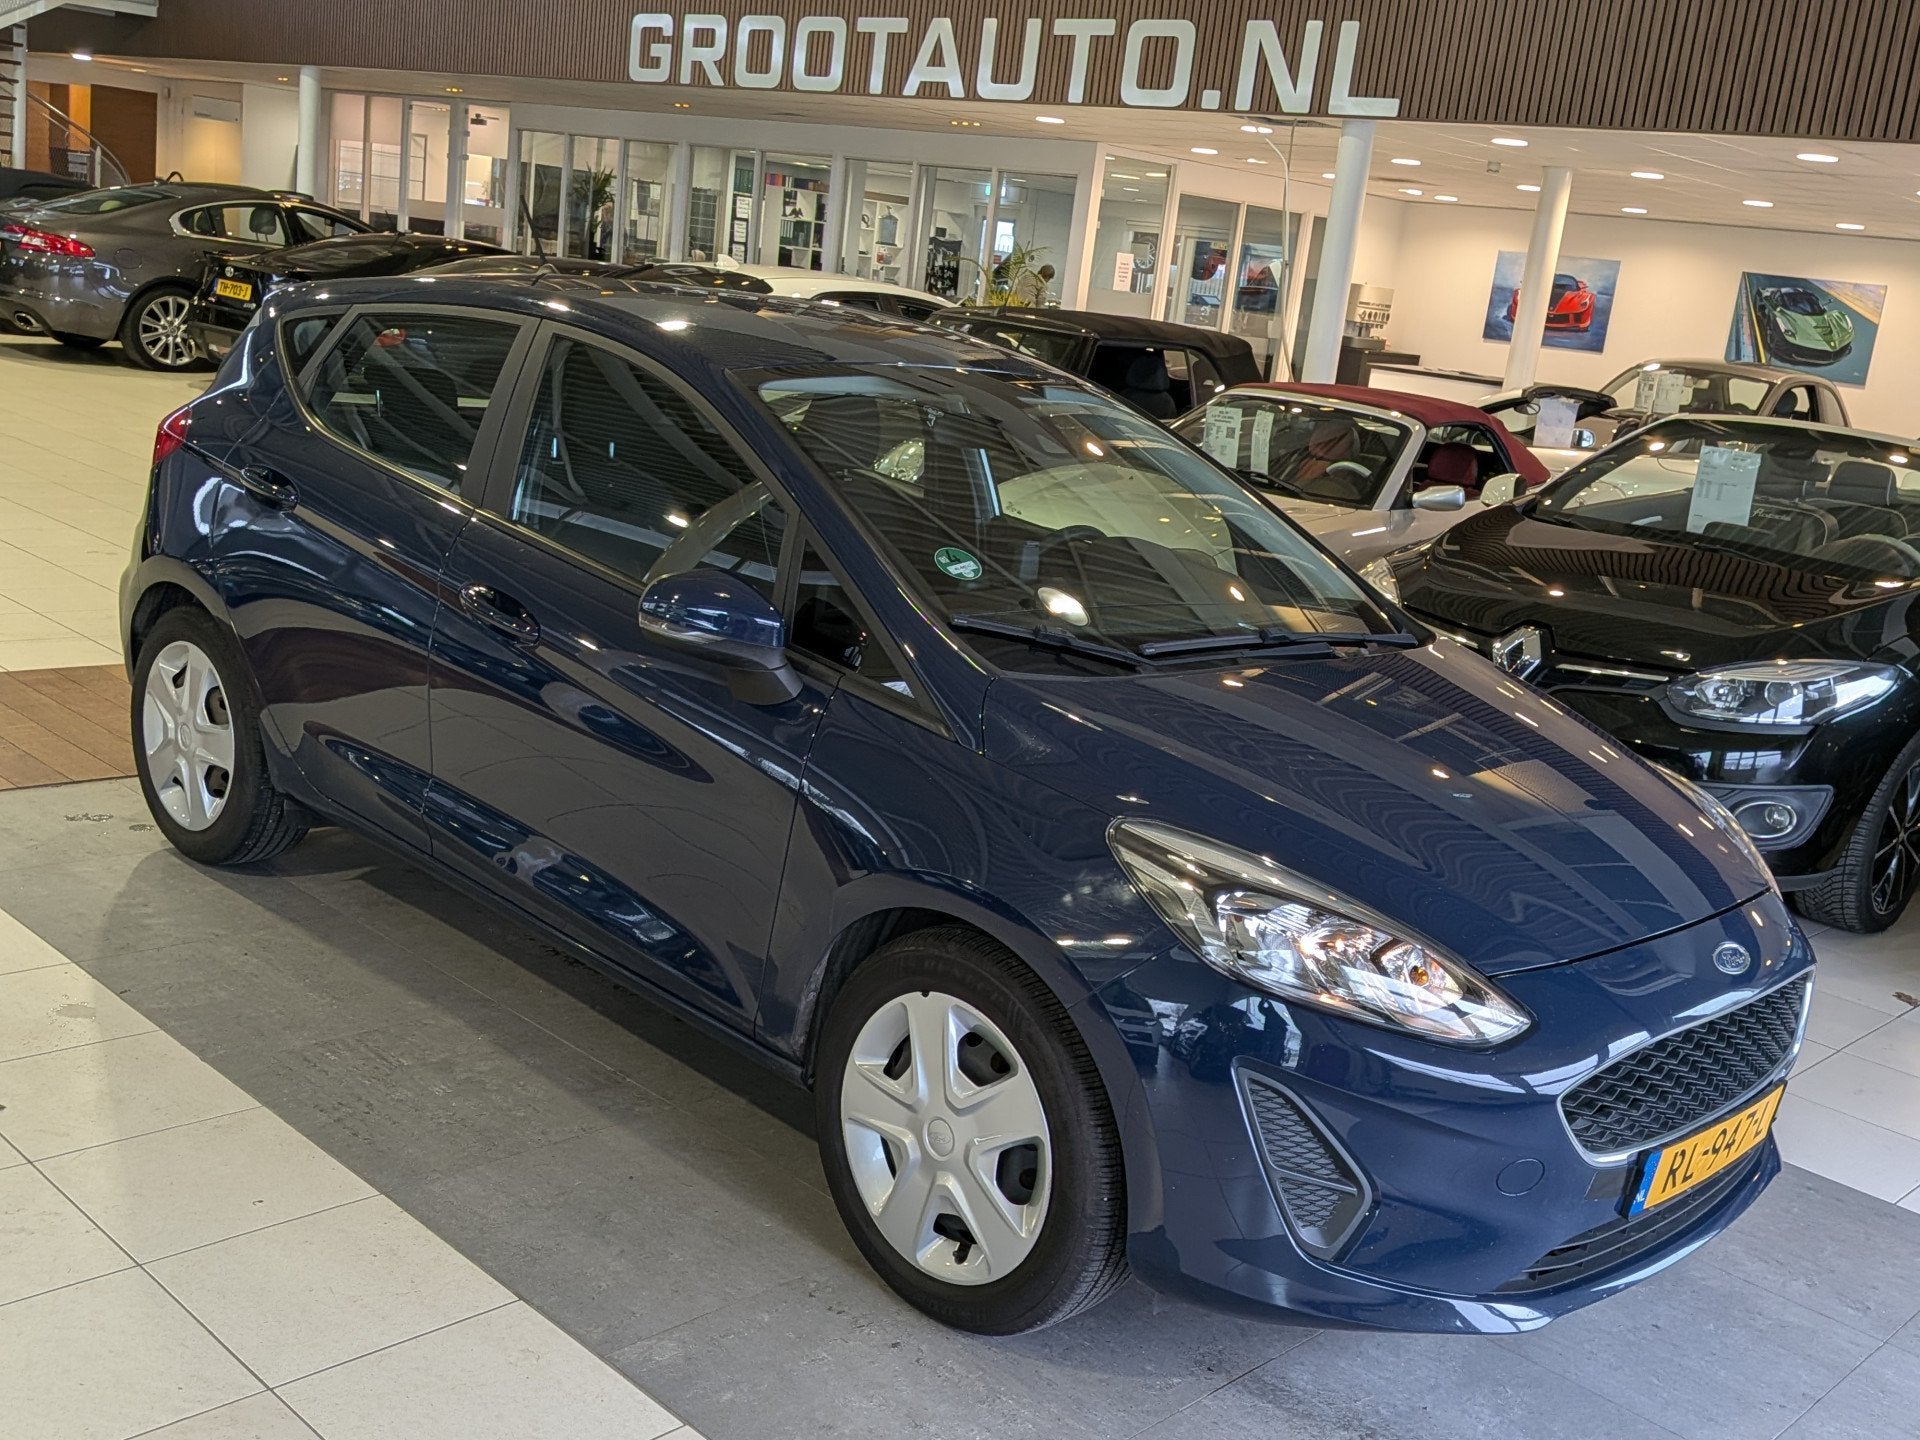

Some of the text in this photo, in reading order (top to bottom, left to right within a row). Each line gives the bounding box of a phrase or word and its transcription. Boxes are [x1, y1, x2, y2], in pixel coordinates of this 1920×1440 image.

[629, 13, 1400, 117] GROOTAUTO.NL
[219, 281, 249, 298] TH-703-J
[1661, 1101, 1770, 1194] RL-947-L
